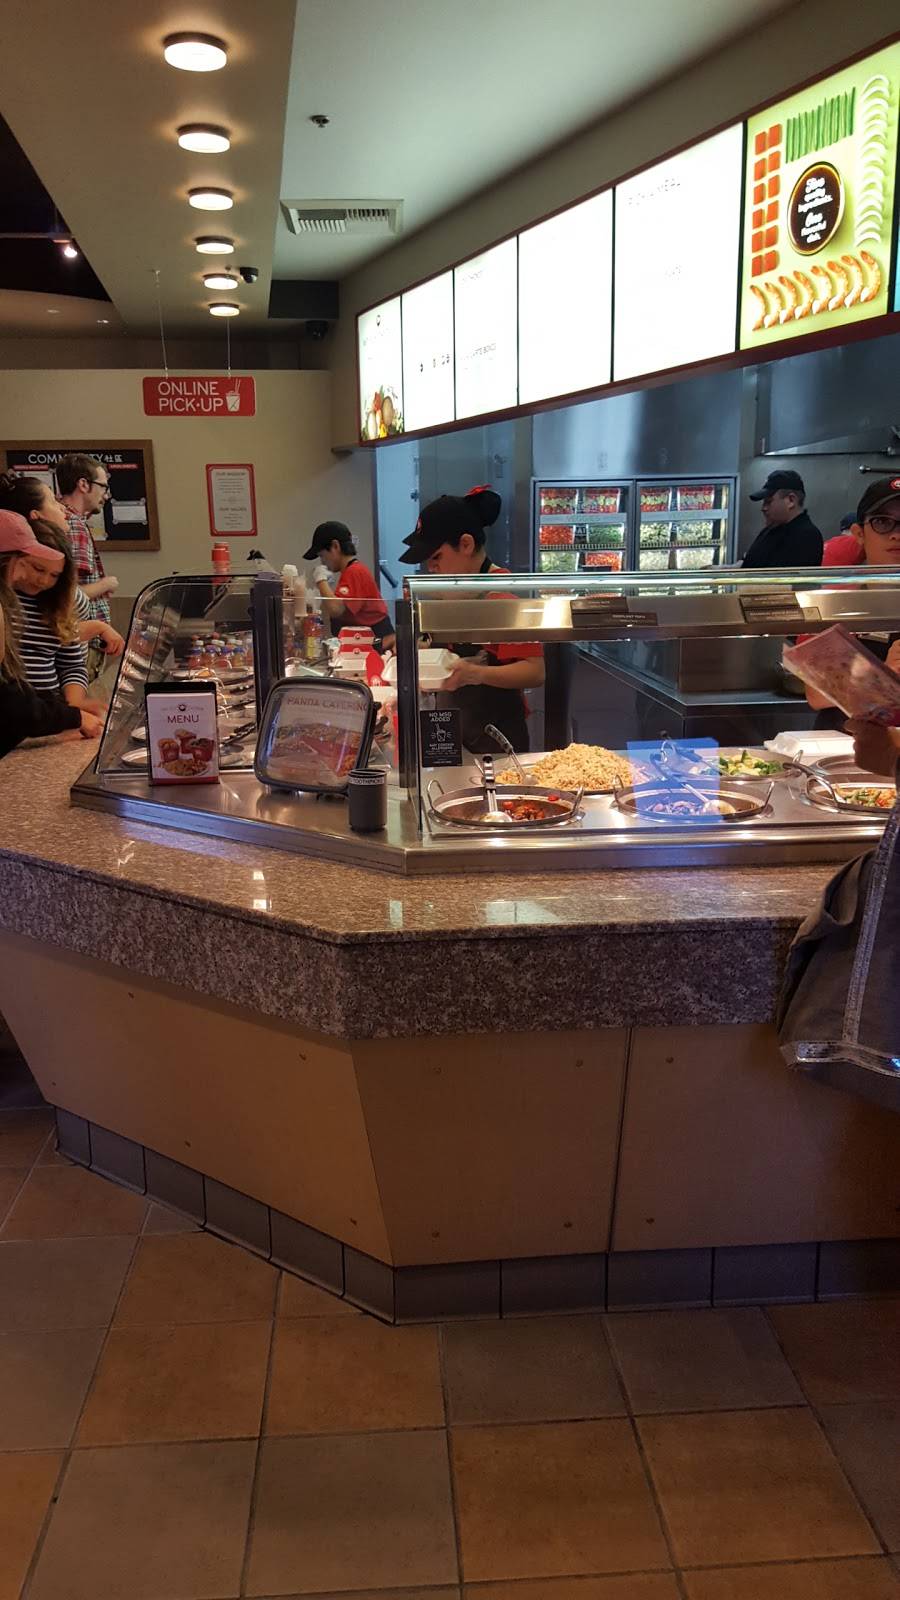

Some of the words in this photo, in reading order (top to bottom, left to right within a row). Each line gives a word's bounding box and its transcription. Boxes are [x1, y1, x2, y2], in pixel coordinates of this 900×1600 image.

[158, 381, 219, 395] ONLINE
[287, 695, 320, 706] PANDA
[167, 714, 200, 724] MENU
